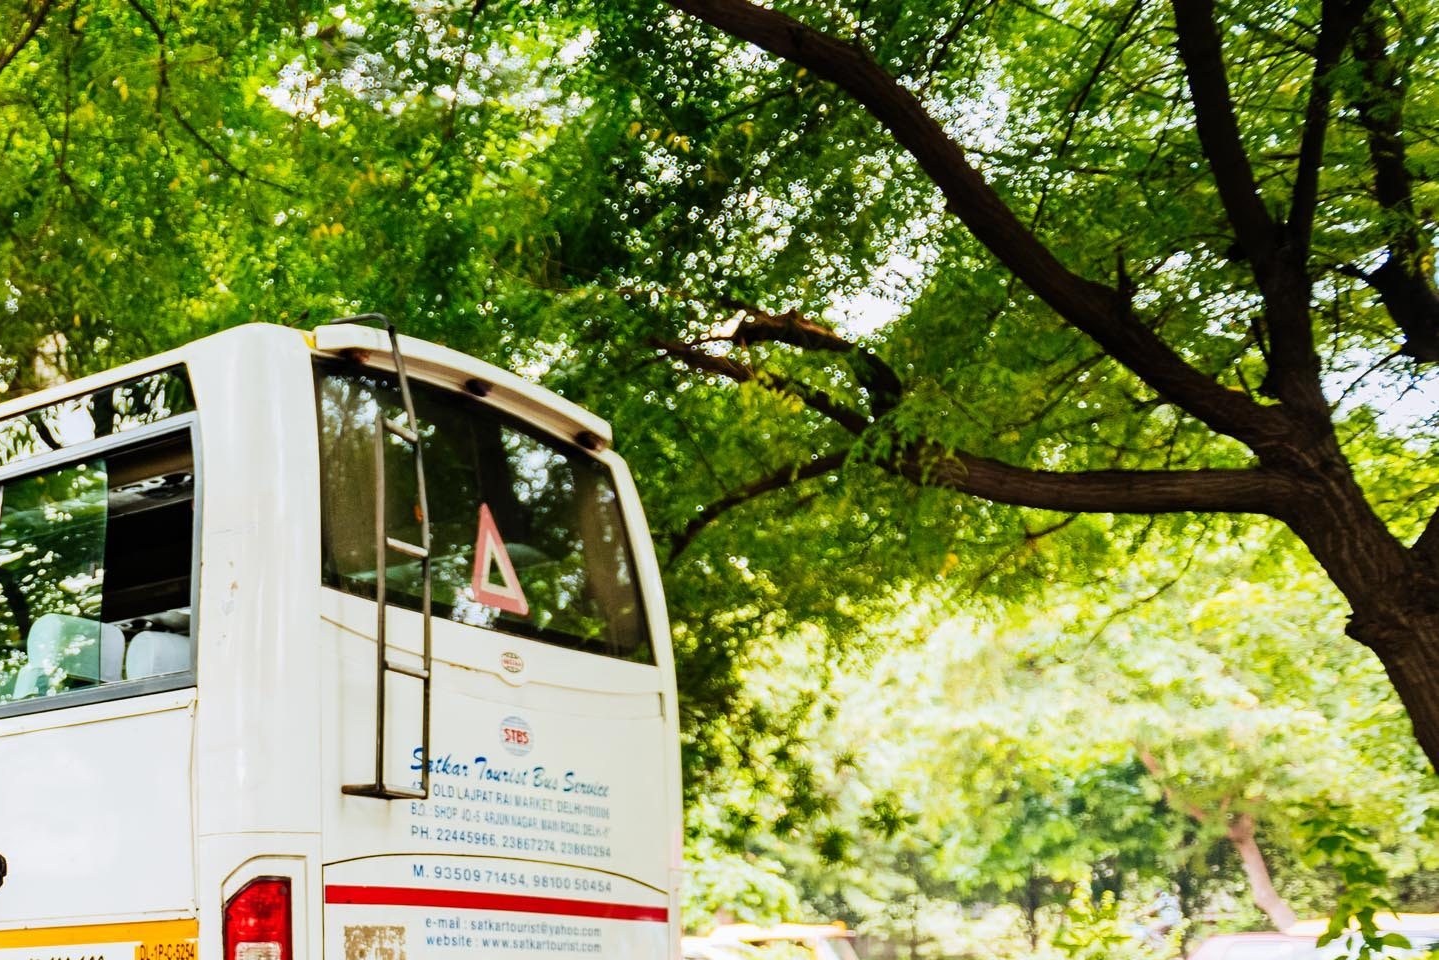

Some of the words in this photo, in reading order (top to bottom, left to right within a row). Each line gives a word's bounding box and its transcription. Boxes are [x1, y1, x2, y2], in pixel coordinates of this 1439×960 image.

[503, 728, 530, 745] STBS
[474, 756, 528, 786] Tourist
[533, 766, 558, 791] Bus
[563, 771, 609, 798] Service
[432, 783, 455, 799] OLD
[457, 787, 494, 804] LAJPAT
[434, 866, 482, 883] 93509
[574, 877, 612, 894] 50454
[425, 934, 473, 949] website
[482, 936, 603, 954] www.satkartourist.com
